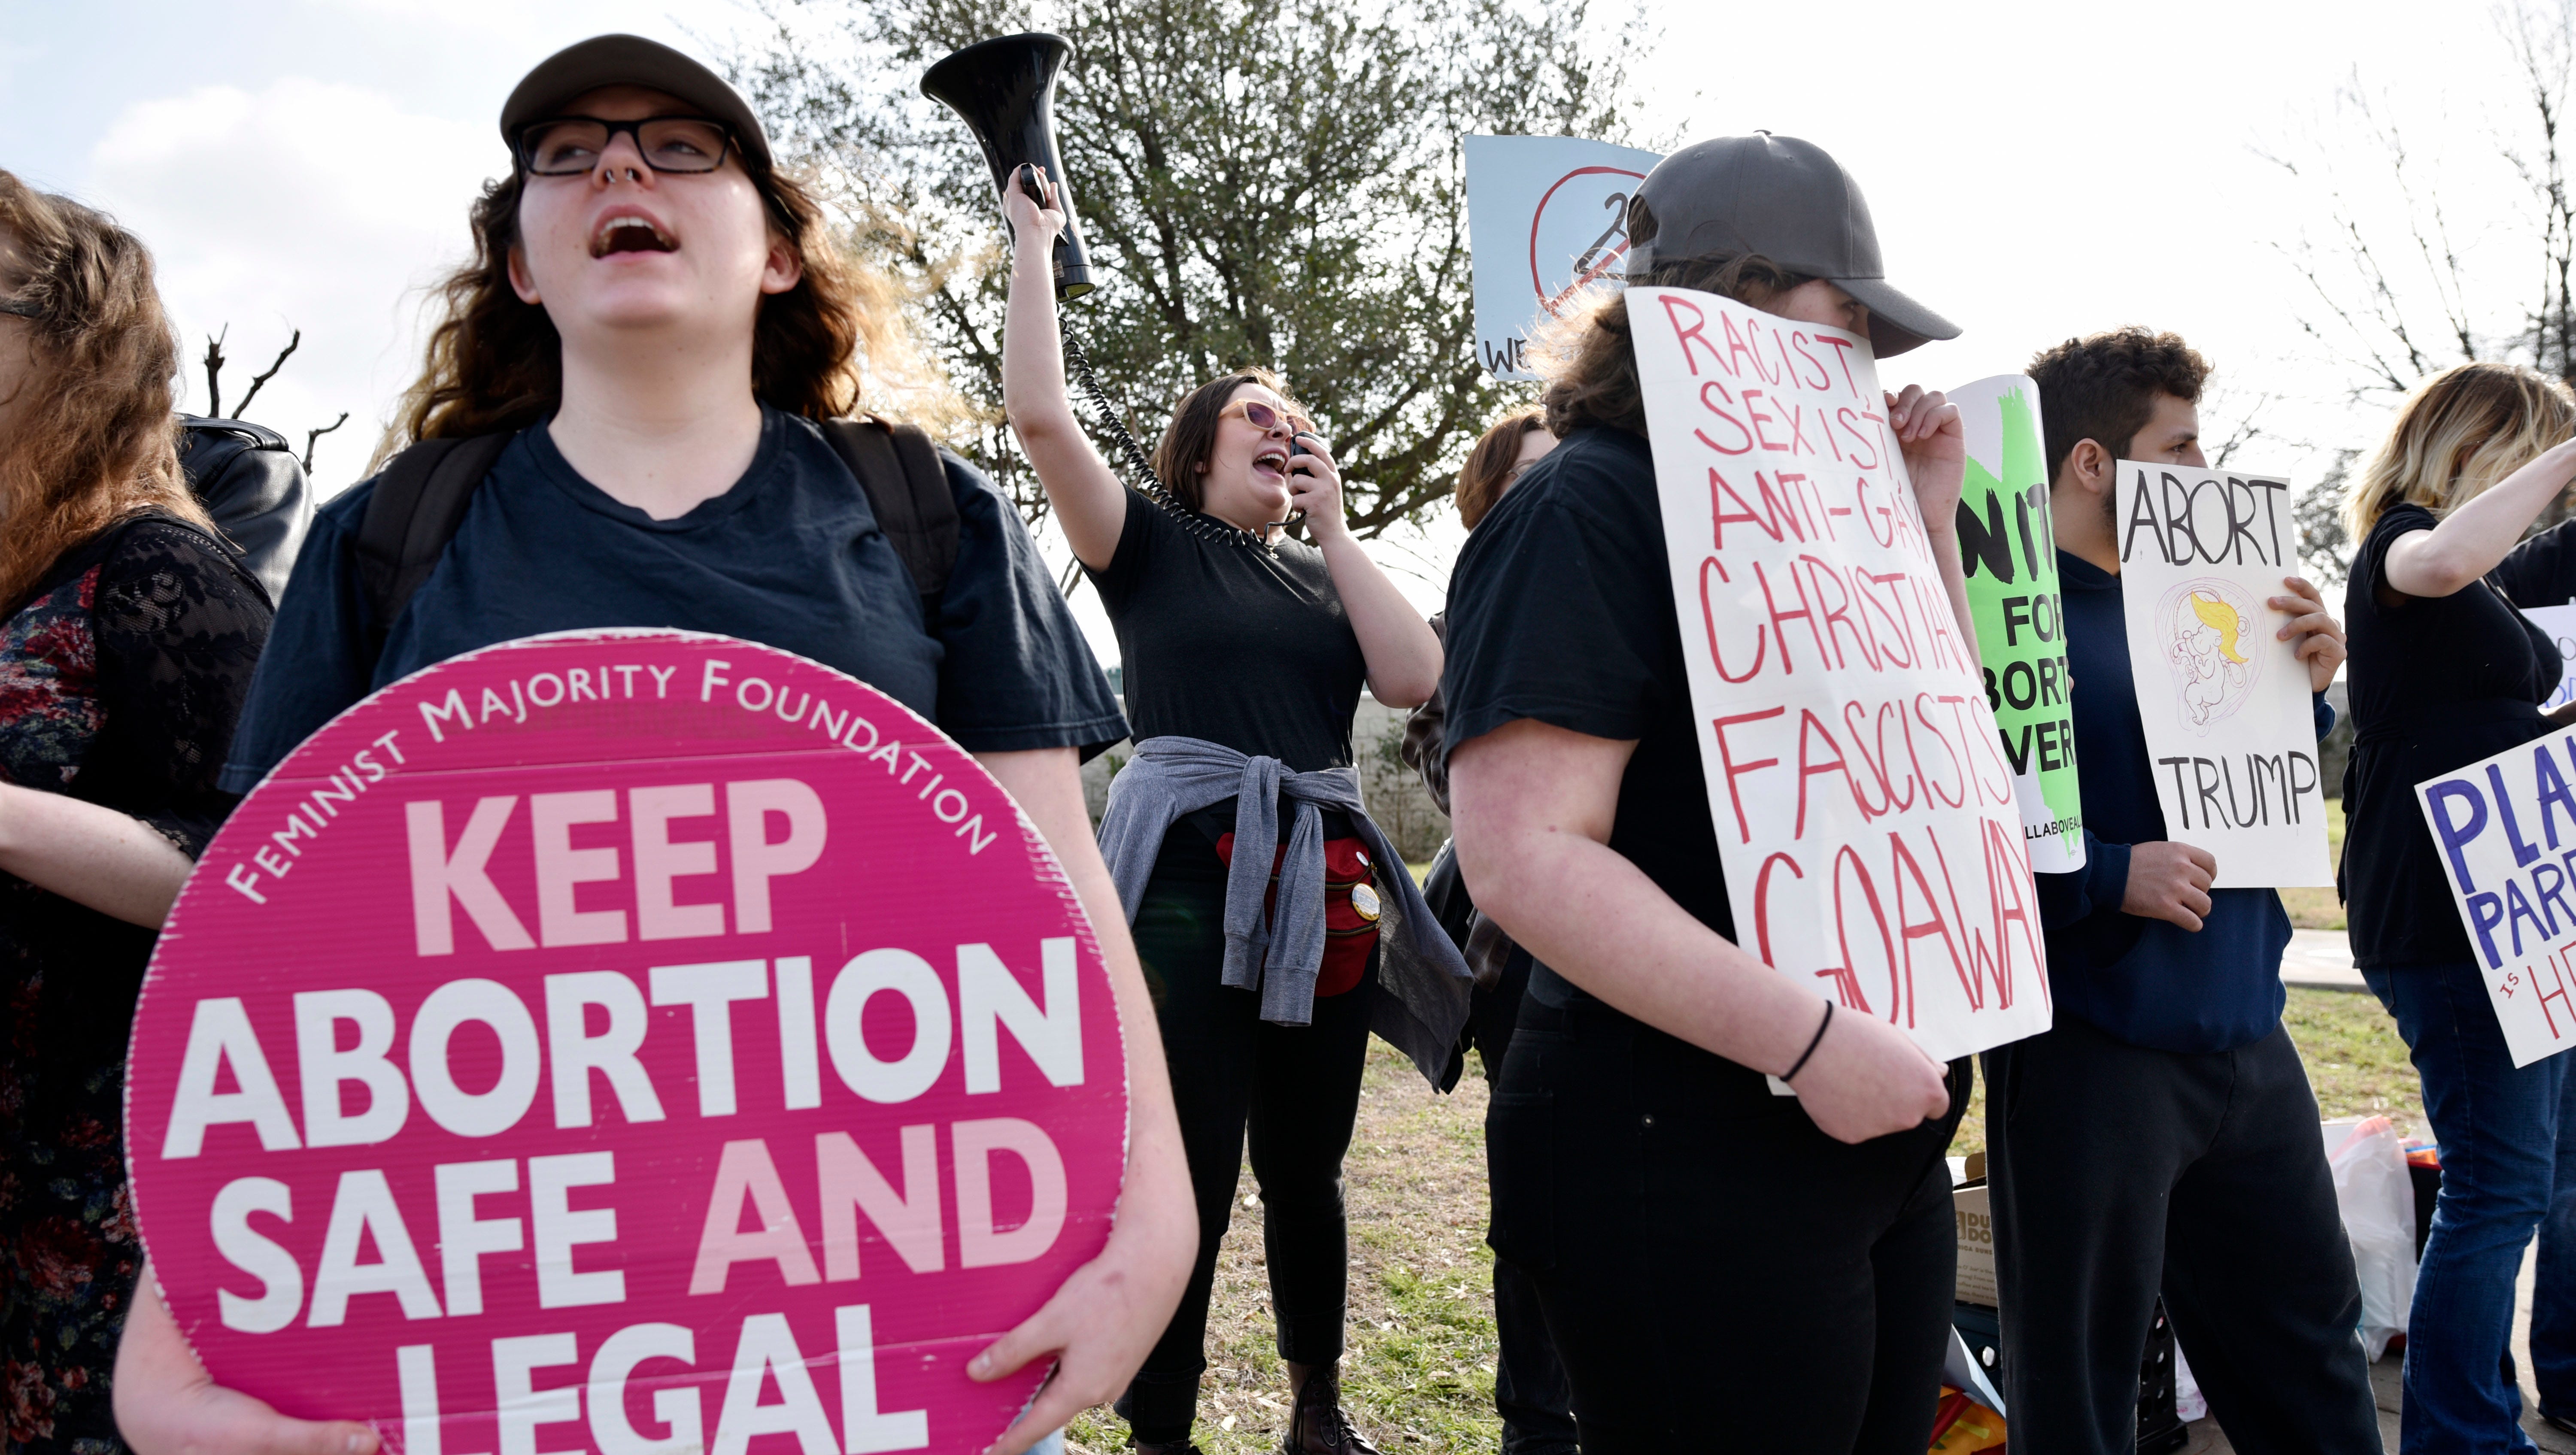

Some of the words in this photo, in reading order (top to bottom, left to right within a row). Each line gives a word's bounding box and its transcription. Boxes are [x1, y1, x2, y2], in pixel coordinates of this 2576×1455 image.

[1955, 483, 2055, 585] NIT
[2121, 469, 2287, 567] ABORT
[1983, 655, 2071, 713] BORT
[225, 730, 406, 905] FEMINIST
[418, 664, 677, 743] MAJORITY
[701, 658, 997, 855] FOUNDATION
[1713, 691, 2011, 843] FASCISTS
[1998, 719, 2076, 776] VER
[2158, 751, 2316, 830] TRUMP
[406, 778, 827, 956] KEEP
[2500, 972, 2519, 999] IS
[161, 936, 1085, 1159] ABORTION
[210, 1151, 626, 1334] SAFE
[689, 1117, 1068, 1295] AND
[1968, 1228, 1992, 1244] DO
[397, 1303, 930, 1455] LEGAL
